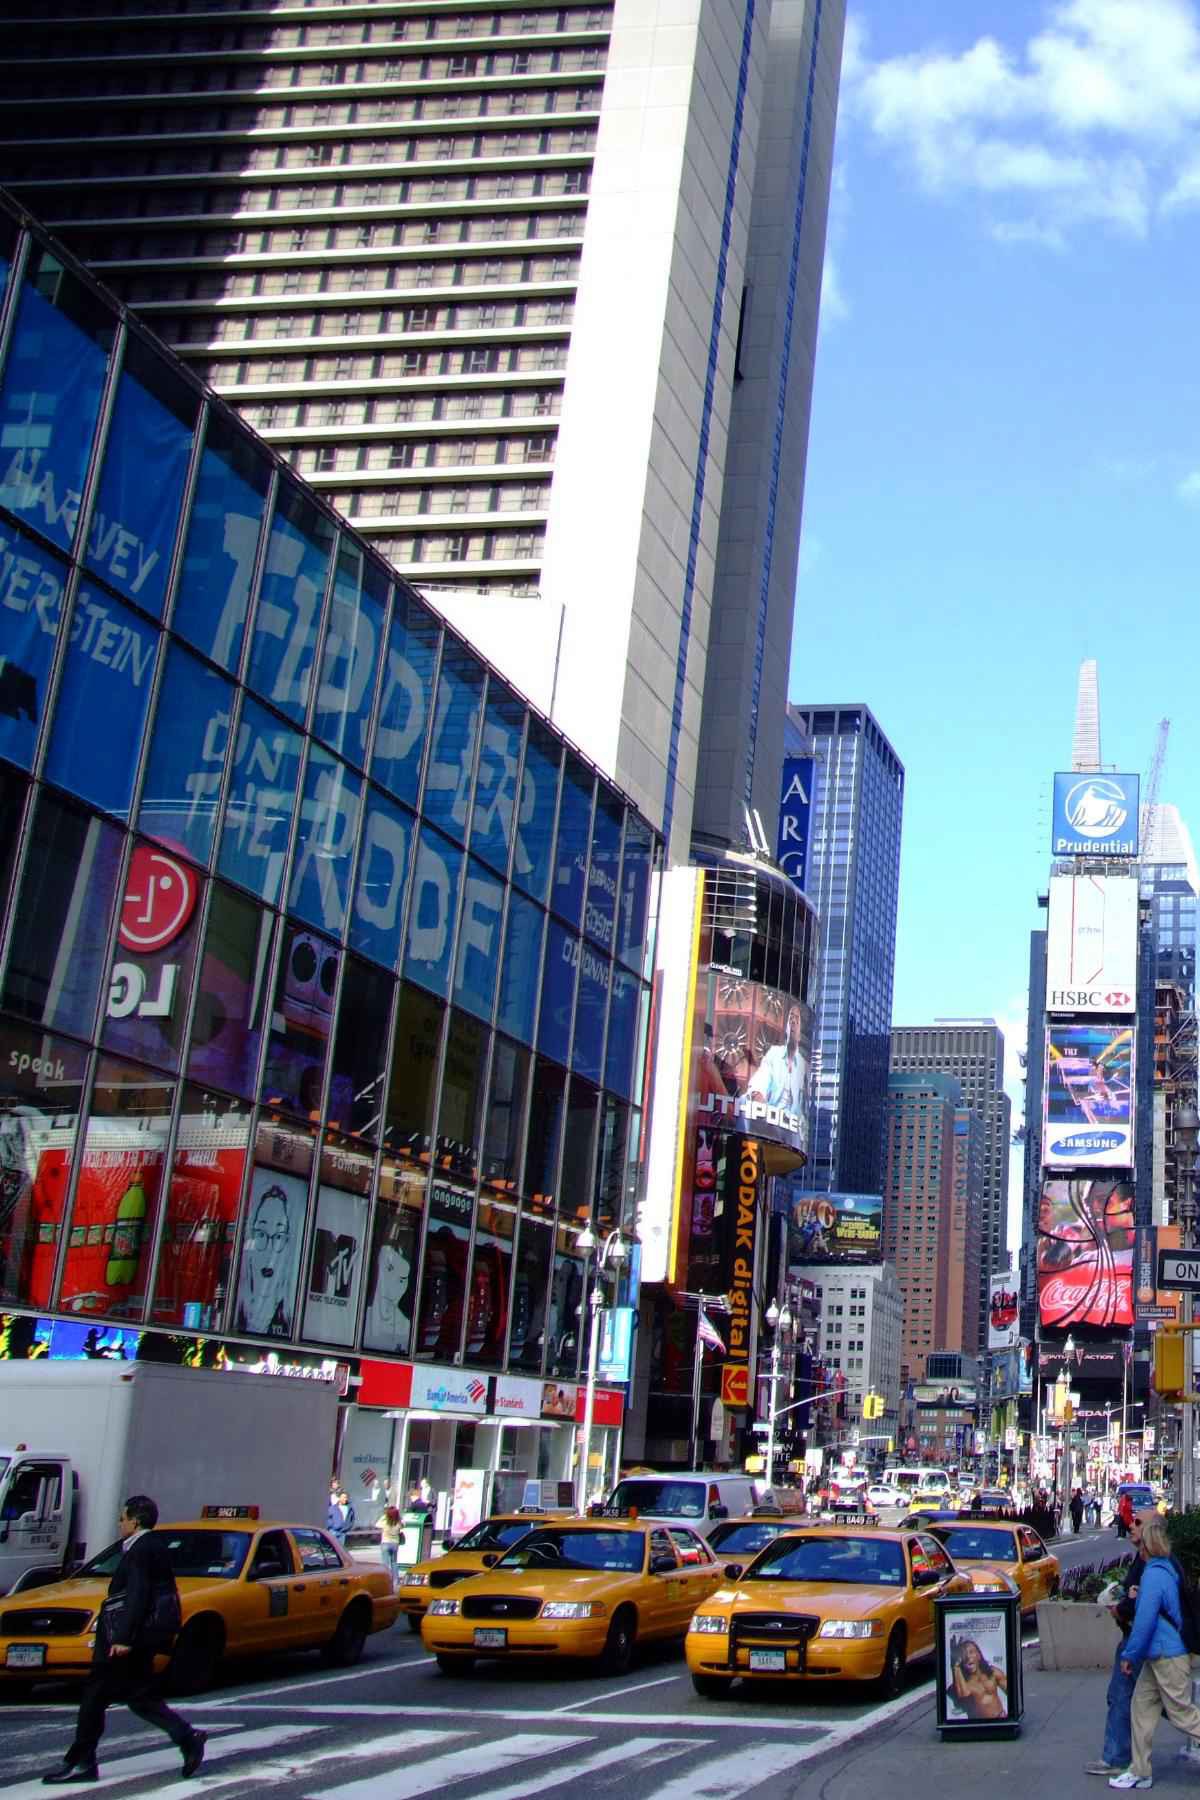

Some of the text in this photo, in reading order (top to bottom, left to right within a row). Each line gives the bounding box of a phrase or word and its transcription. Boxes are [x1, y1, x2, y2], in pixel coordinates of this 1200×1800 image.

[203, 711, 285, 783] ON
[186, 771, 280, 857] THE
[1056, 839, 1133, 854] Prudential
[289, 768, 503, 990] ROOF
[1050, 990, 1102, 1006] HSBC
[8, 1050, 65, 1081] speak
[1059, 1137, 1118, 1149] SAMSUNG
[728, 1139, 759, 1358] KODAK digital
